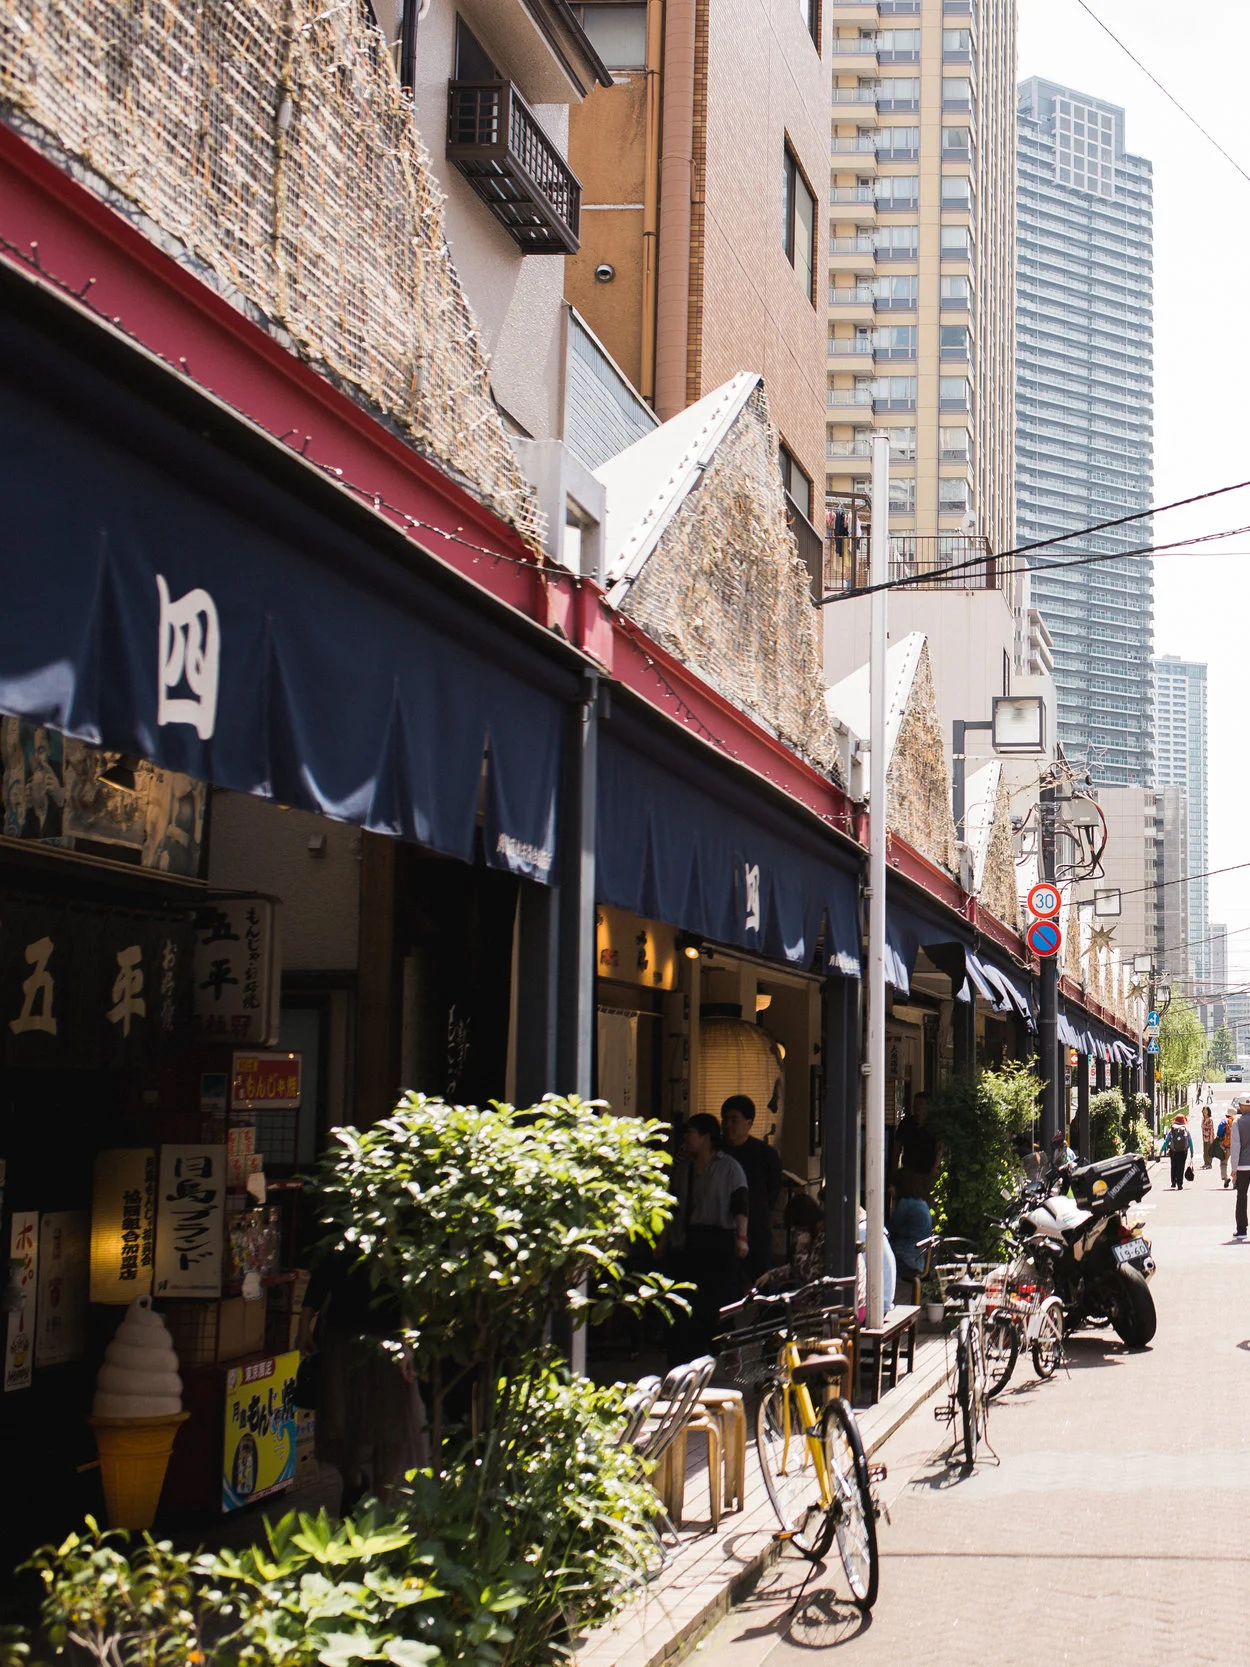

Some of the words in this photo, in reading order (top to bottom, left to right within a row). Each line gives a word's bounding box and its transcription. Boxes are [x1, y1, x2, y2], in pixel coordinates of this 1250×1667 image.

[156, 572, 221, 741] 四
[1035, 893, 1054, 909] 30
[200, 912, 240, 1001] 五平
